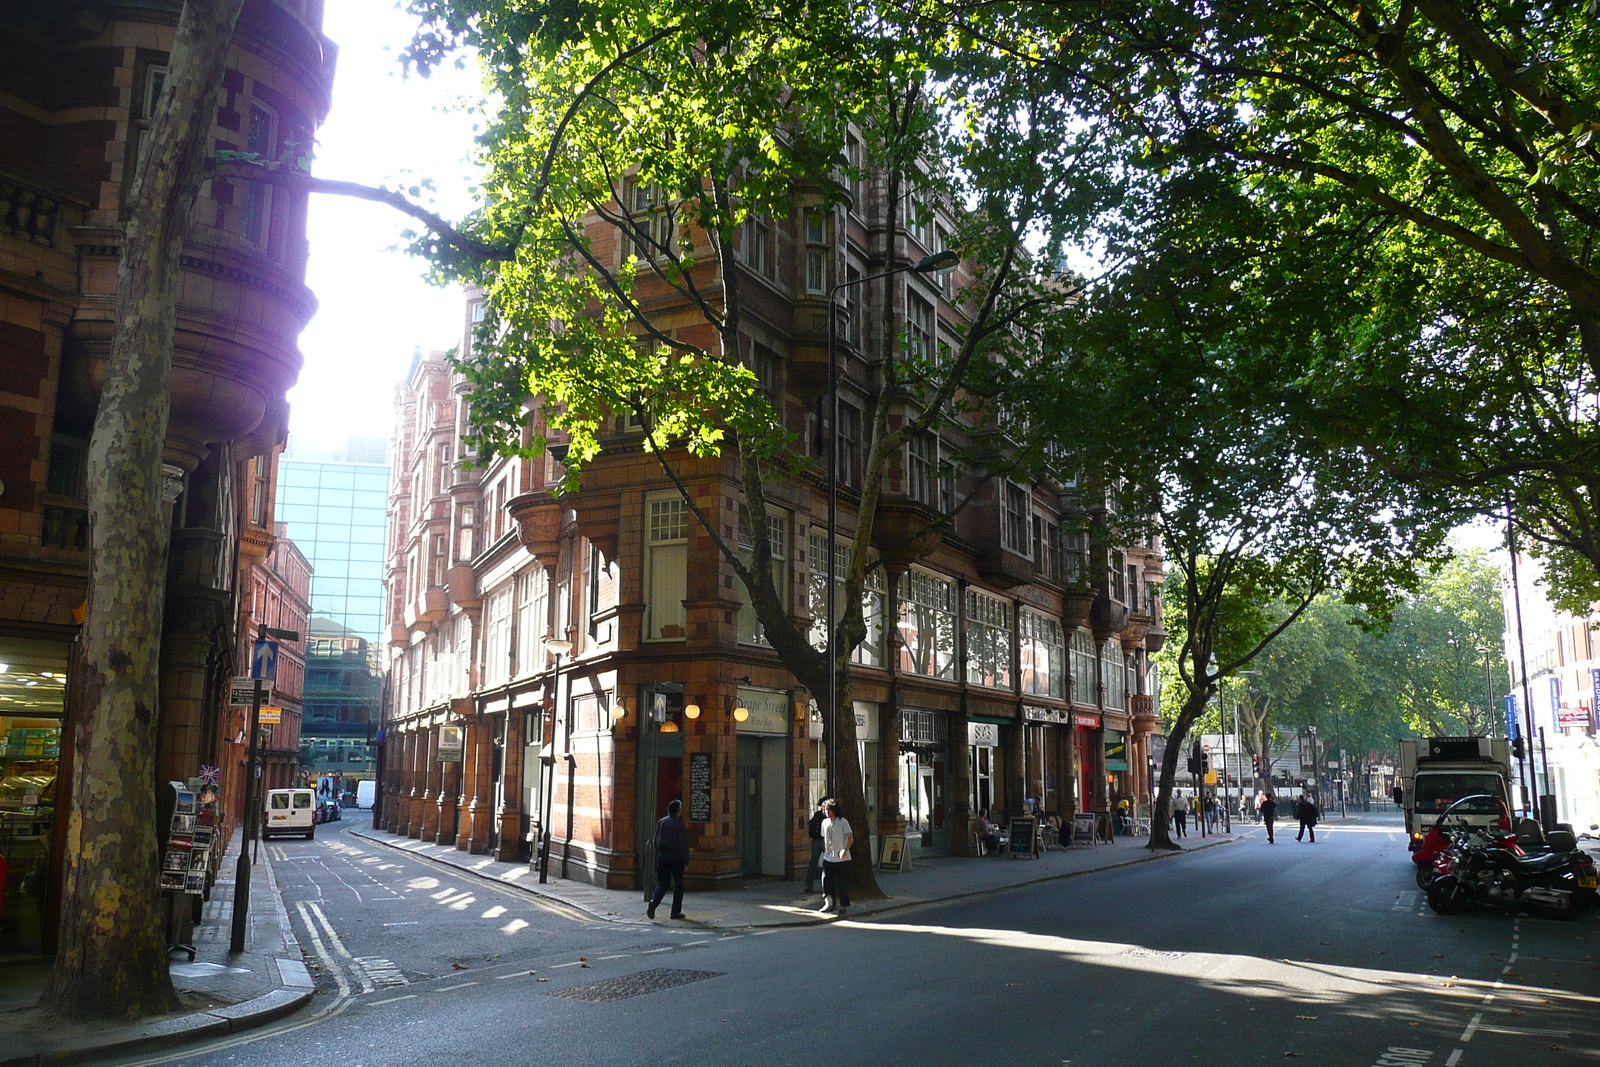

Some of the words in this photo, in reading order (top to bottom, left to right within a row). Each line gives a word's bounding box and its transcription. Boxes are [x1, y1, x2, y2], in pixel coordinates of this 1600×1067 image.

[738, 696, 761, 713] Grape
[764, 698, 787, 713] Street
[750, 716, 763, 726] Wine
[764, 718, 774, 727] Bar
